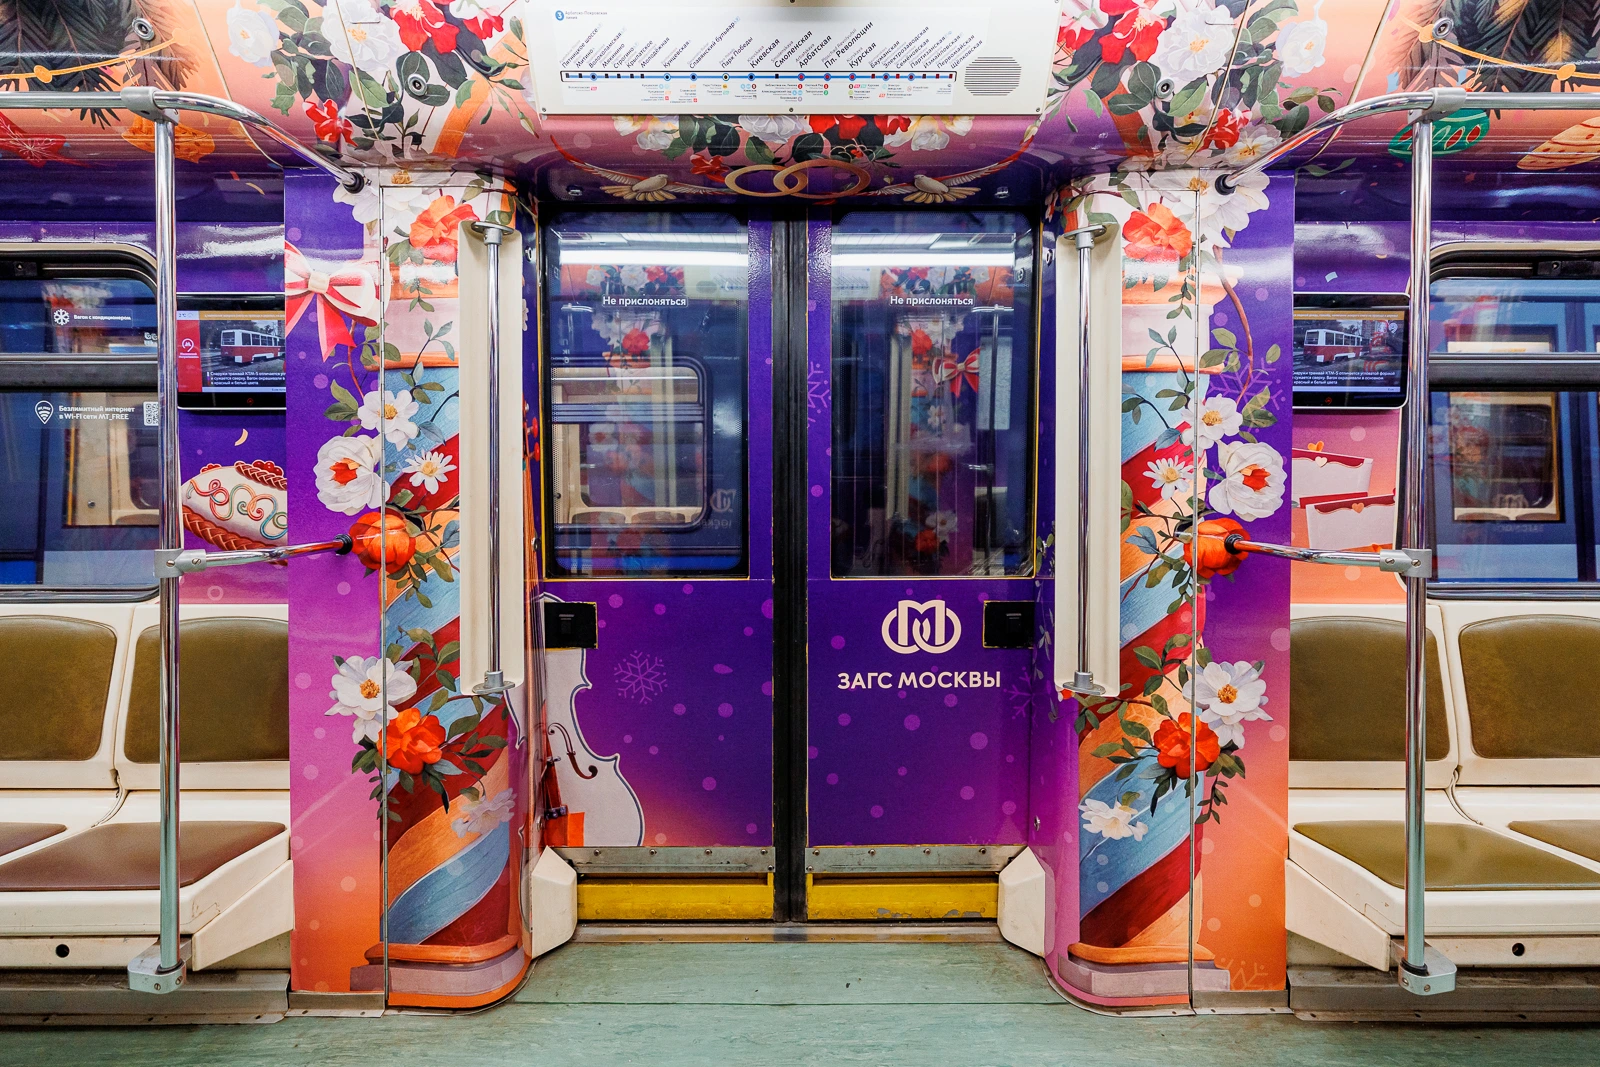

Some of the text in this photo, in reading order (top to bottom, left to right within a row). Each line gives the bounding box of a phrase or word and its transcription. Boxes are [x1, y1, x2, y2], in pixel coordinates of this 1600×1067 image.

[562, 42, 585, 68] Пятницкое
[576, 49, 594, 68] Митино
[588, 32, 622, 68] Волоколамская
[602, 43, 625, 68] Мякинино
[613, 47, 634, 69] Строгино
[626, 40, 653, 69] Крылатское
[663, 41, 690, 69] Кунцевская
[689, 41, 716, 69] Славянский
[715, 22, 735, 42] бульвар
[721, 55, 734, 69] Парк
[733, 37, 753, 57] Победы
[750, 38, 780, 69] Киевская
[774, 30, 813, 69] Смоленская
[799, 35, 832, 69] Арбатская
[824, 57, 837, 69] Пл.
[836, 21, 874, 57] Революции
[849, 42, 877, 69] Курская
[870, 40, 900, 69] Бауманская
[884, 26, 929, 69] Электрозаводская
[910, 36, 945, 69] Партизанская
[924, 35, 961, 69] Измайловская
[936, 34, 975, 69] Первомайская
[602, 296, 686, 307] Не прислоняться
[890, 296, 974, 306] Не прислоняться
[98, 413, 129, 421] MT_FREE
[837, 670, 1001, 690] ЗАГС МОСКВЫ
